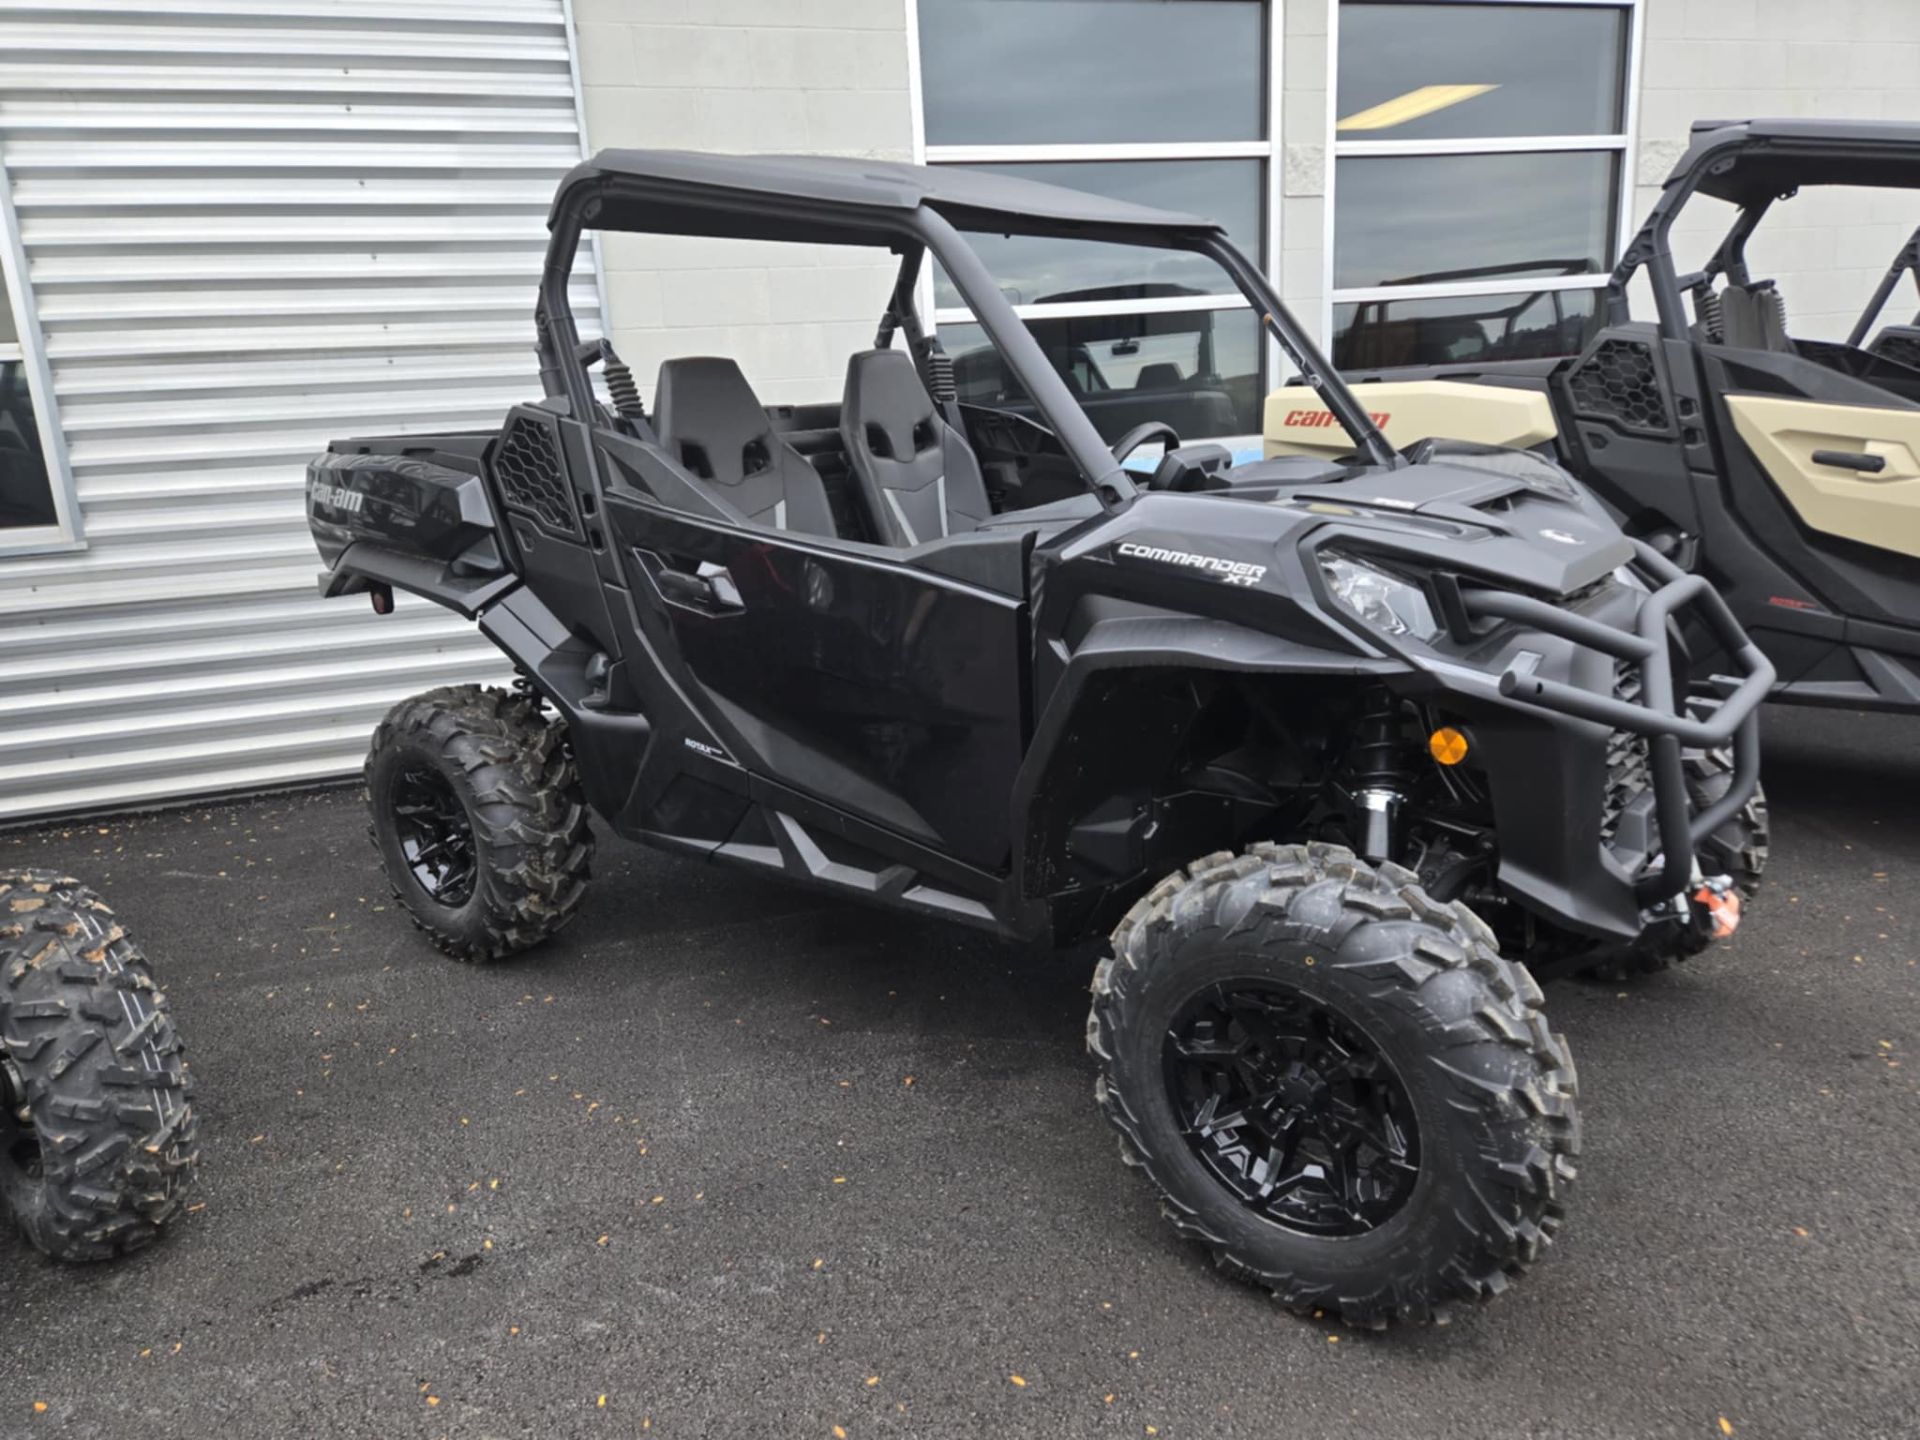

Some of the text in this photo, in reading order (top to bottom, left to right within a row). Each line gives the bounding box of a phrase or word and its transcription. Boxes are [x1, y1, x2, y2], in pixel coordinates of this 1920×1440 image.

[1283, 410, 1391, 430] can-m
[311, 481, 364, 513] can-am
[1118, 543, 1267, 578] COMMANDER
[1223, 573, 1260, 586] XT
